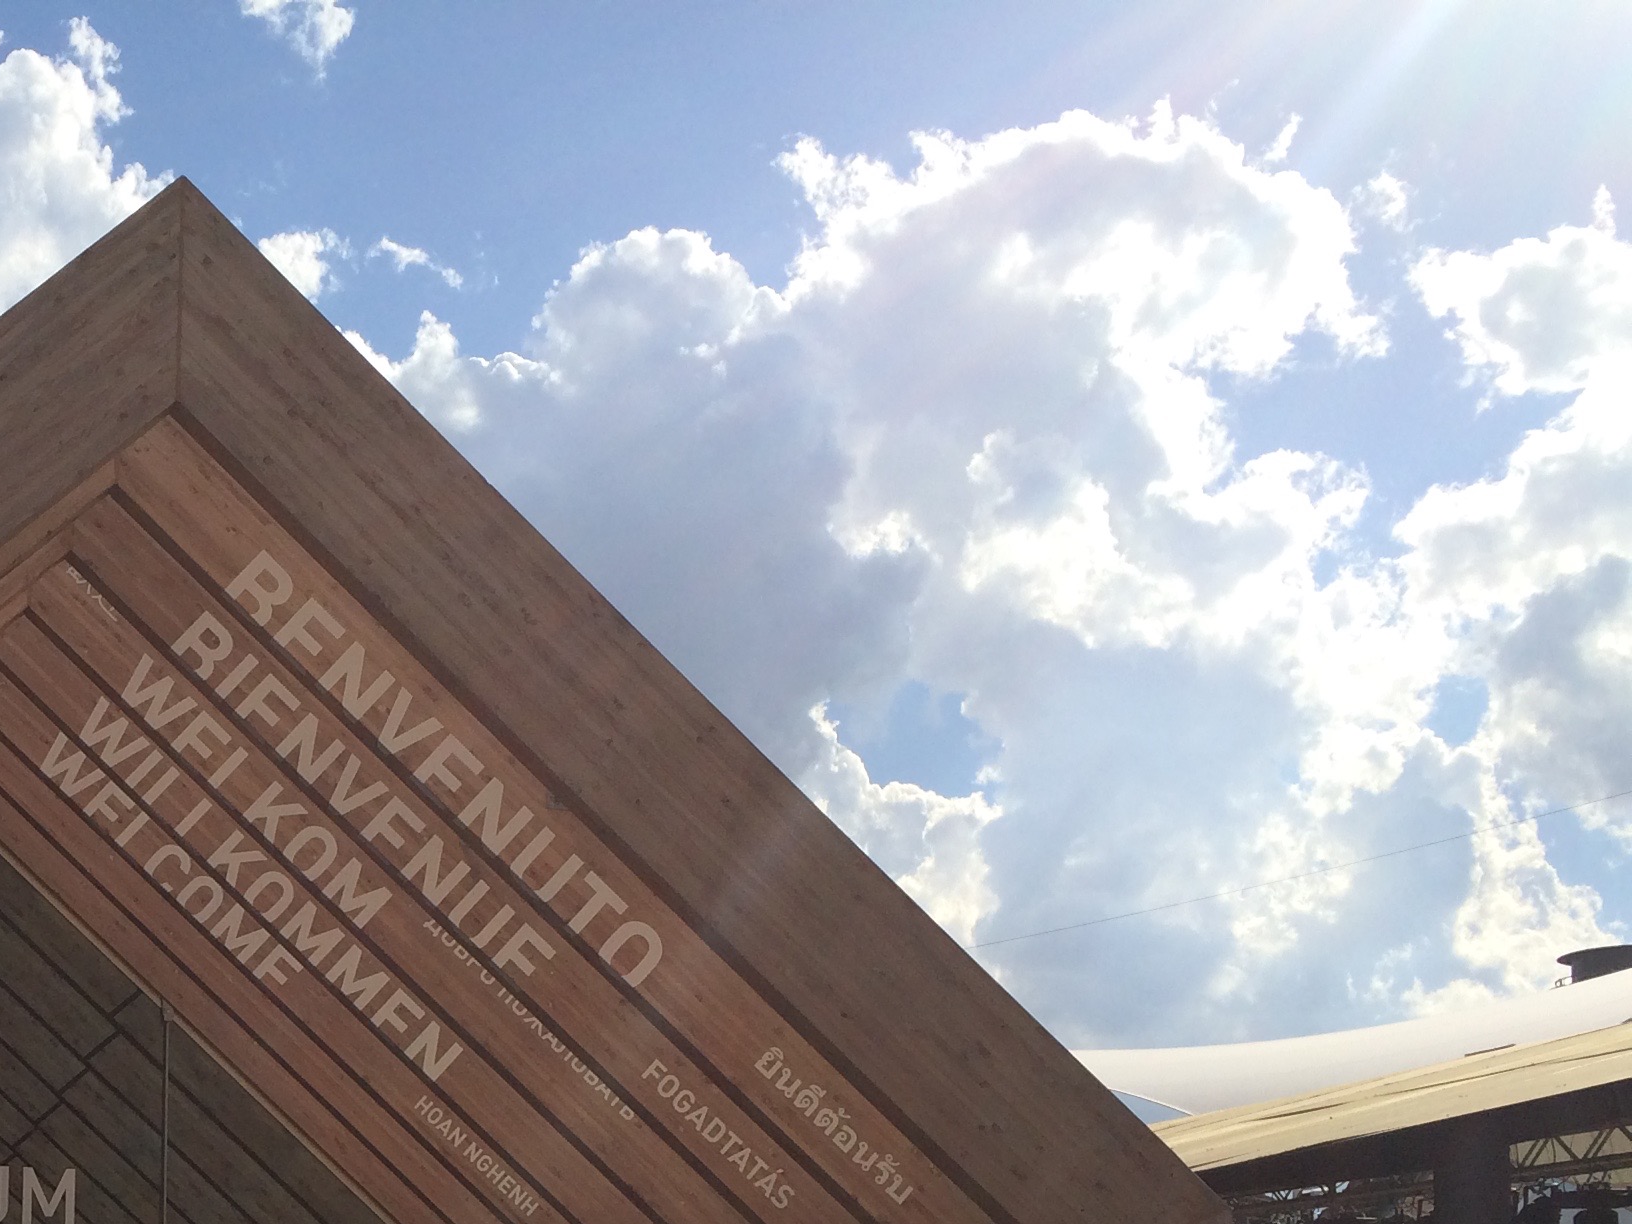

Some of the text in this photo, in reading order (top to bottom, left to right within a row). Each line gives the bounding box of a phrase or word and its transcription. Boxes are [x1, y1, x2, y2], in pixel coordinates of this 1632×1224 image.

[413, 1095, 540, 1217] HOAN NGHENH
[640, 1057, 796, 1211] FOGADTATÁS
